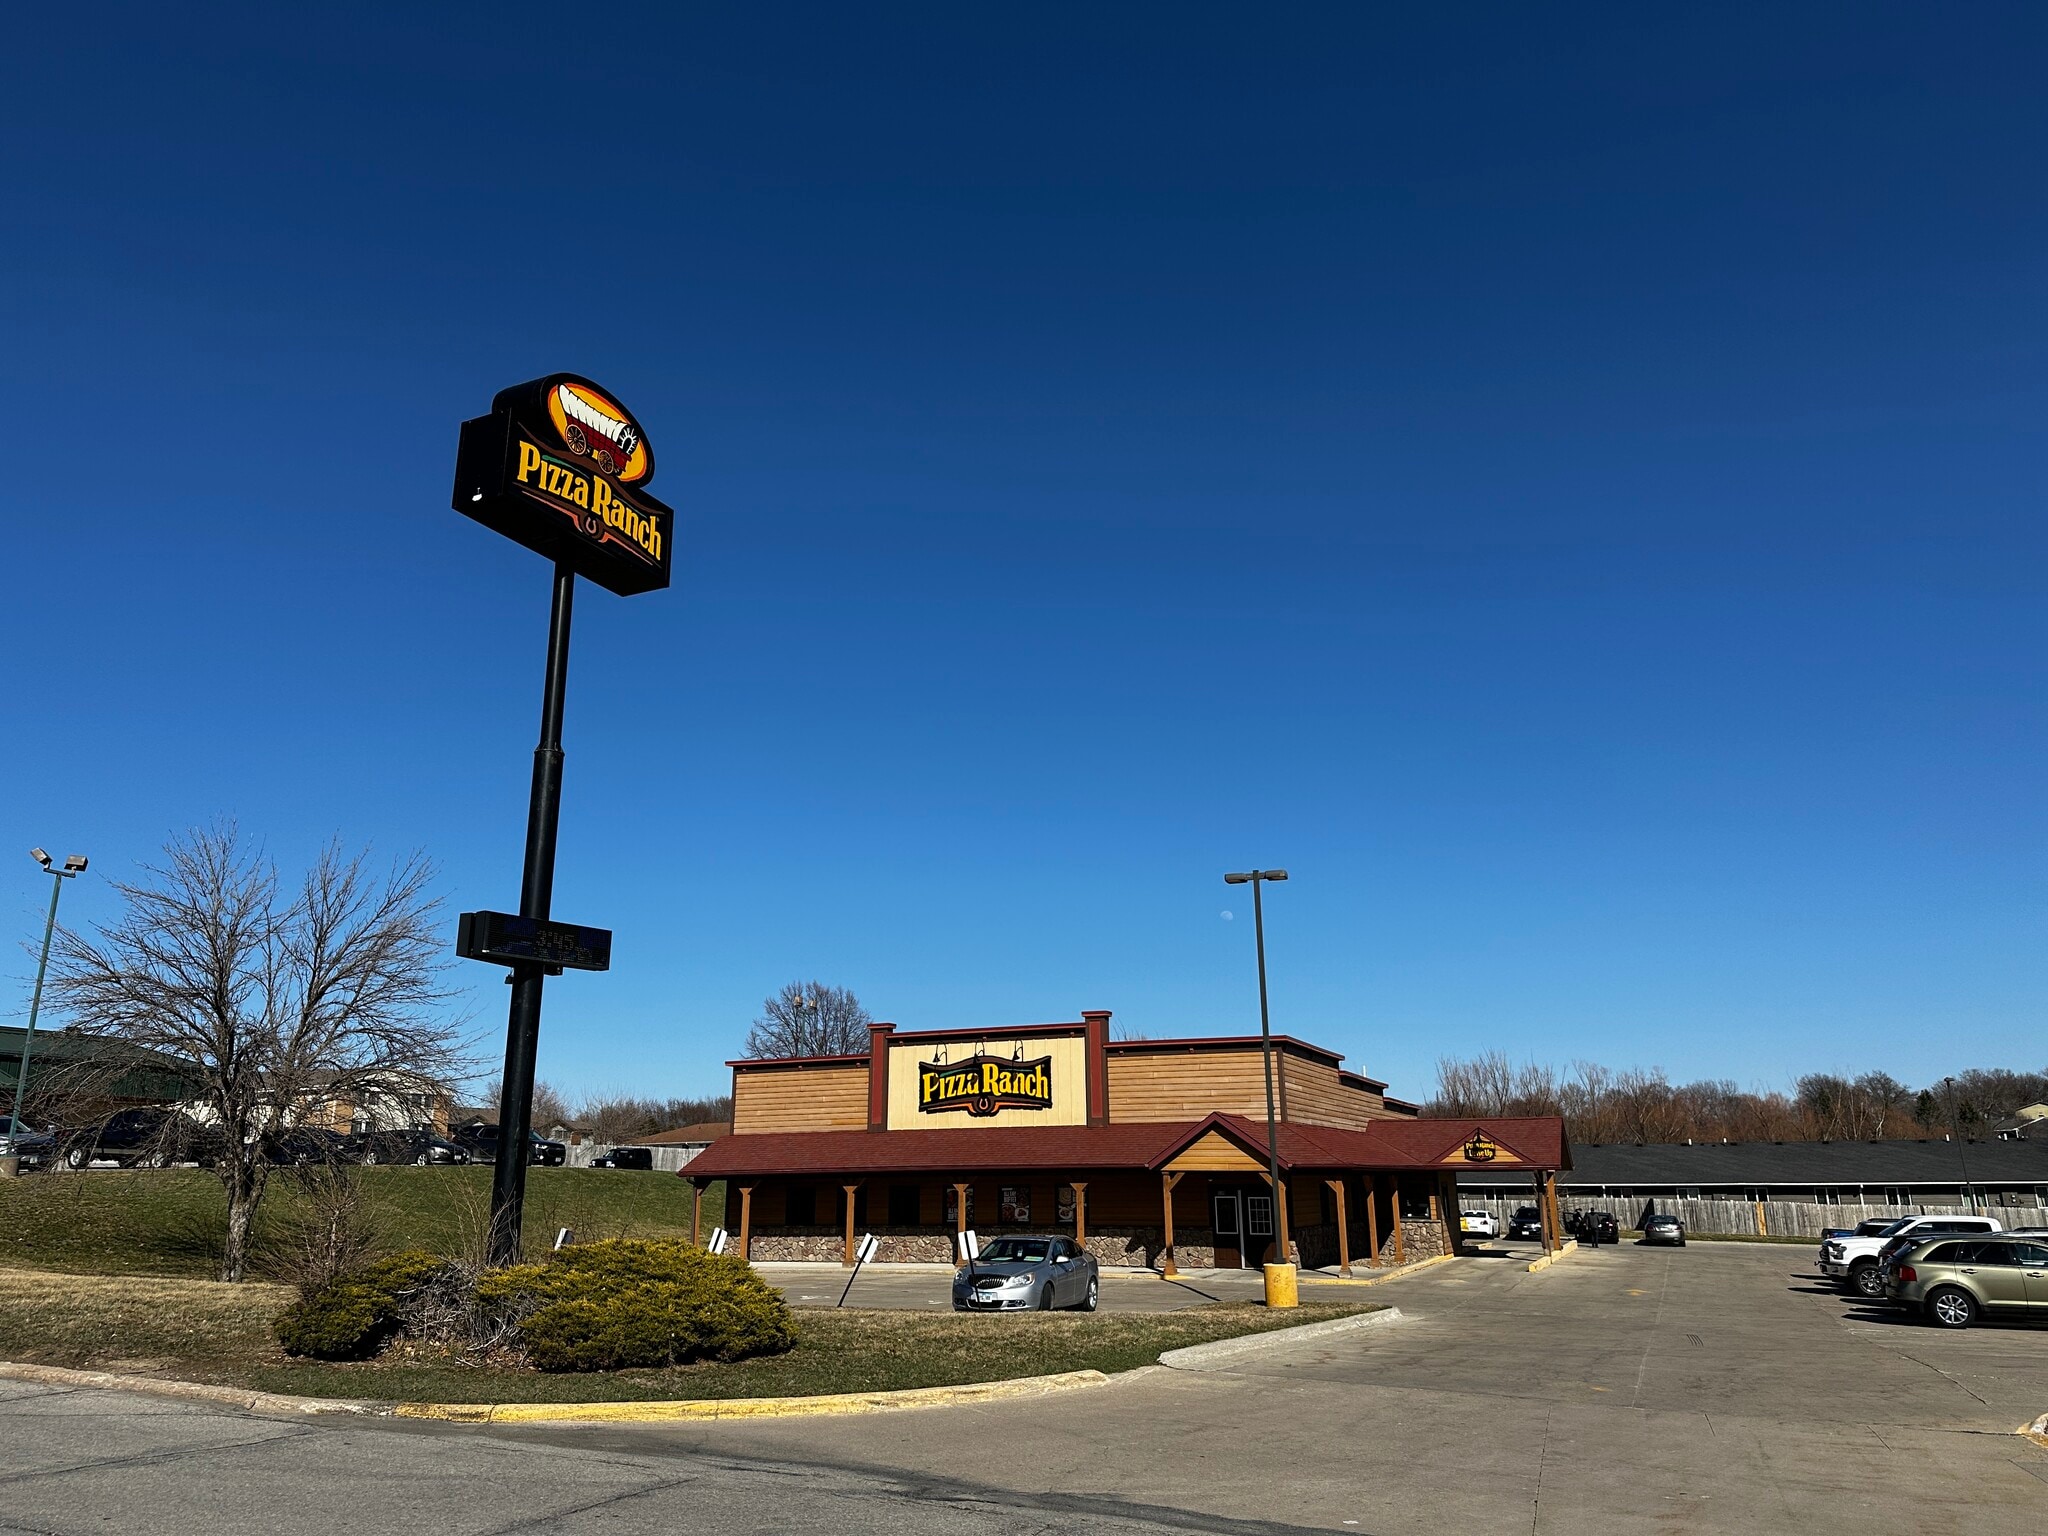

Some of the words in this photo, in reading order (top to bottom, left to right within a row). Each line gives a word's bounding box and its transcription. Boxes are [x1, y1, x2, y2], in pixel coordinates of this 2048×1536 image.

[517, 440, 588, 509] Pizza
[591, 474, 661, 561] Ranch
[922, 1072, 979, 1103] Pizza
[982, 1063, 1049, 1099] Ranch
